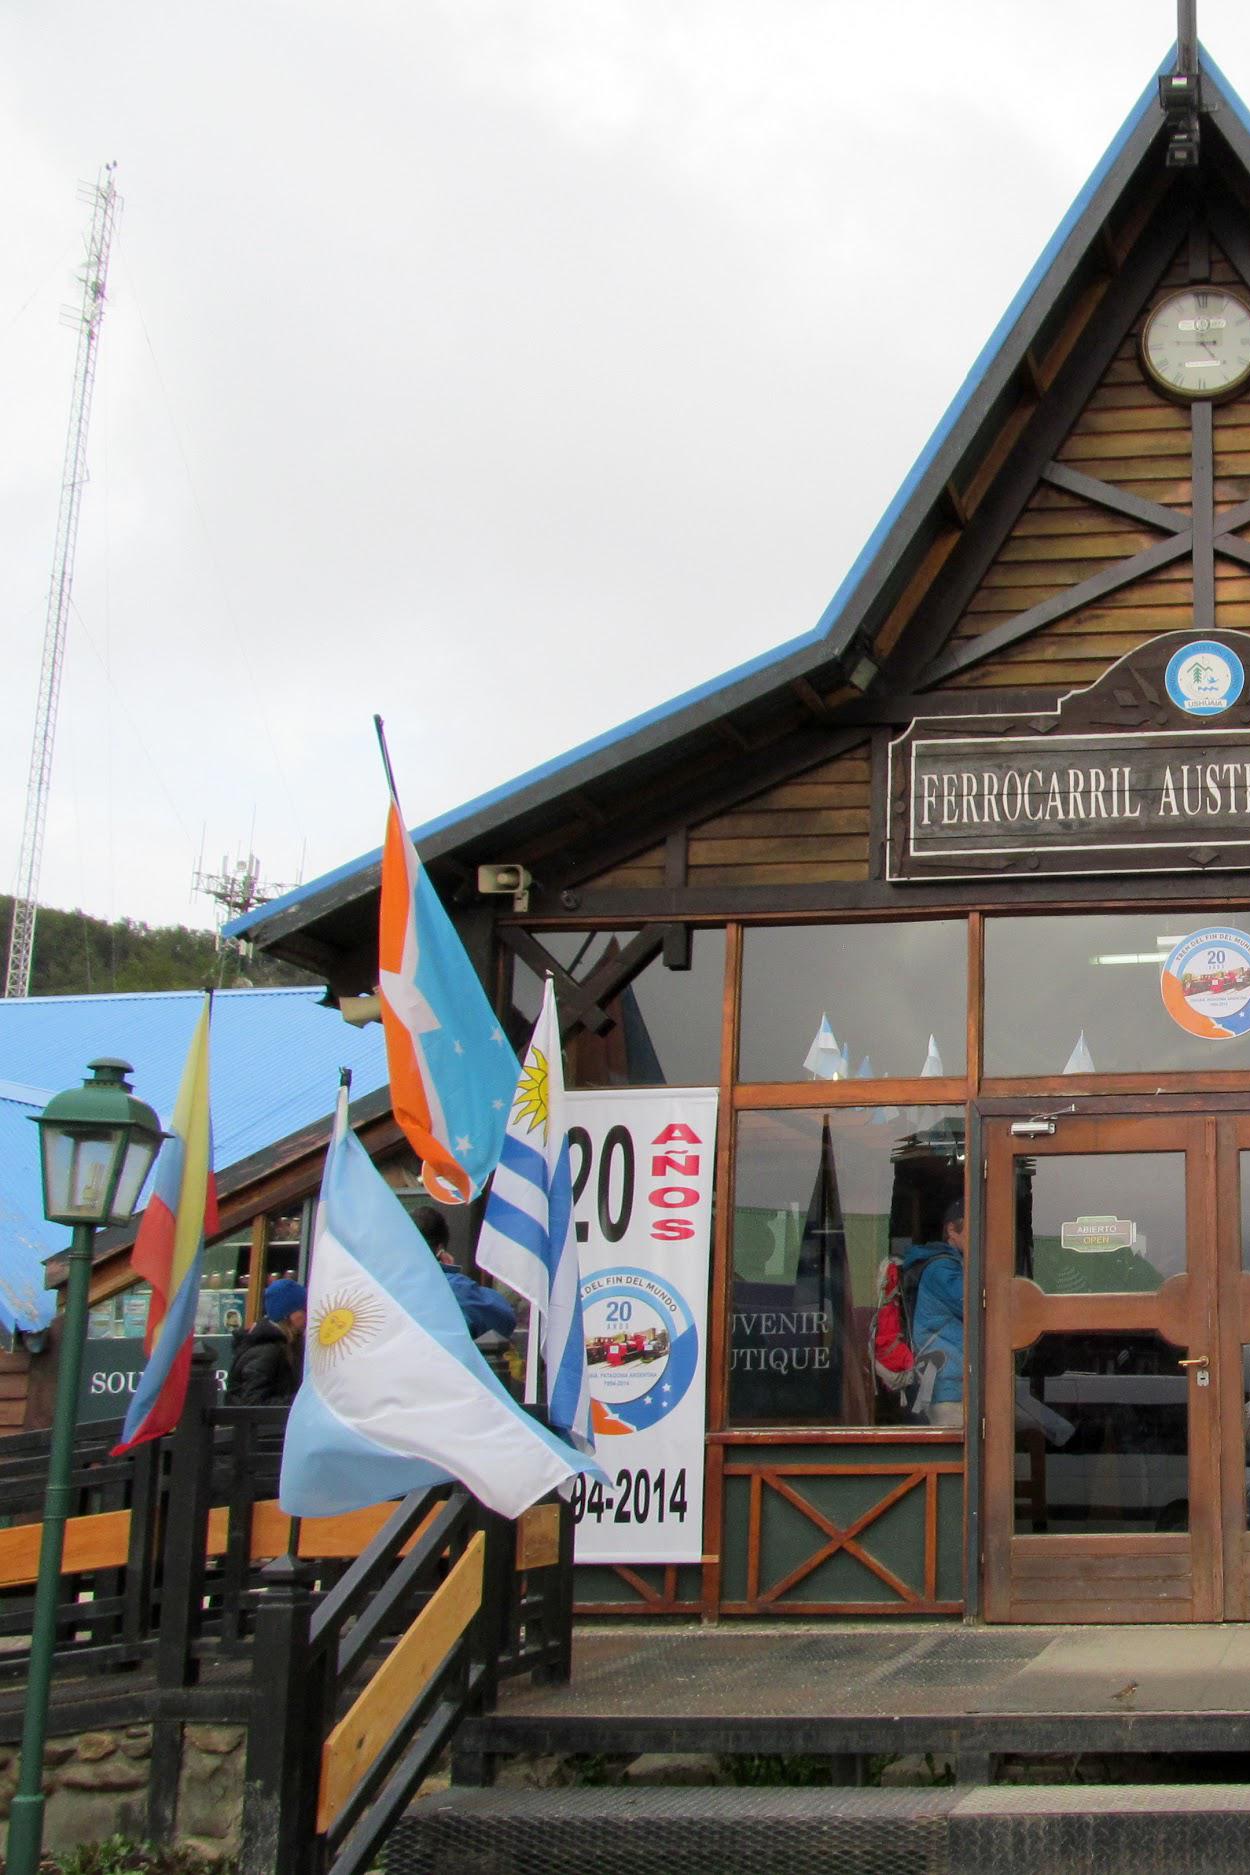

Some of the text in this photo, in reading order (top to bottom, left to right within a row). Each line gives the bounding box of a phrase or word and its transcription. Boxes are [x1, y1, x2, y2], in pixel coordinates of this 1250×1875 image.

[919, 767, 1141, 825] FERROCARRIL
[1175, 946, 1190, 961] TREN
[1190, 936, 1204, 947] DEL
[1205, 933, 1218, 941] FIN
[1219, 933, 1232, 941] DEL
[1207, 950, 1226, 965] 20
[567, 1124, 635, 1243] 20
[648, 1123, 704, 1242] AÑOS
[1077, 1225, 1117, 1234] ABIERTO
[1083, 1235, 1110, 1245] OPEN
[584, 1276, 678, 1313] DEL FIN DEL MUNDO
[606, 1301, 633, 1322] 20
[732, 1312, 829, 1335] VENIR
[731, 1347, 830, 1375] TIQUE
[570, 1467, 688, 1525] 94-2014
